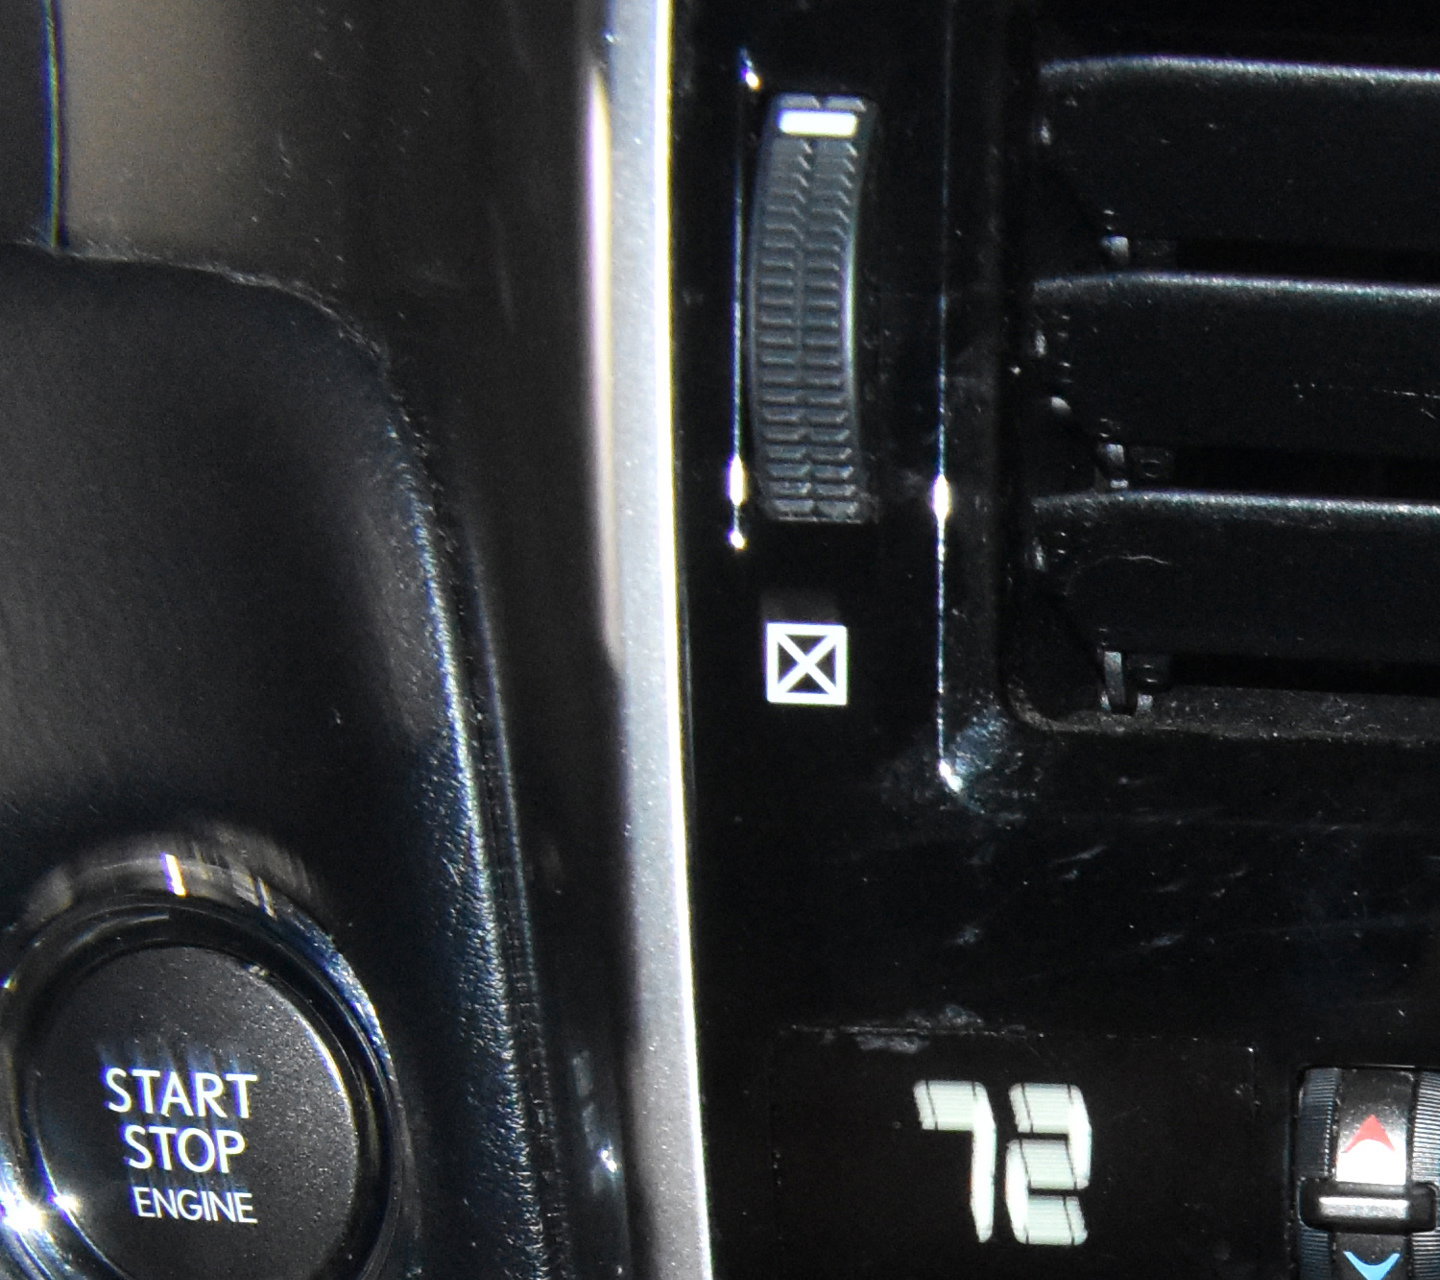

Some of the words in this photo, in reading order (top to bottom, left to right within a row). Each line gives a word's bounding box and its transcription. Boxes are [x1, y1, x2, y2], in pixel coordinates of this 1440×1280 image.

[102, 1066, 258, 1120] START
[122, 1123, 245, 1174] STOP
[914, 1081, 1092, 1245] 72
[132, 1185, 258, 1224] ENGINE
